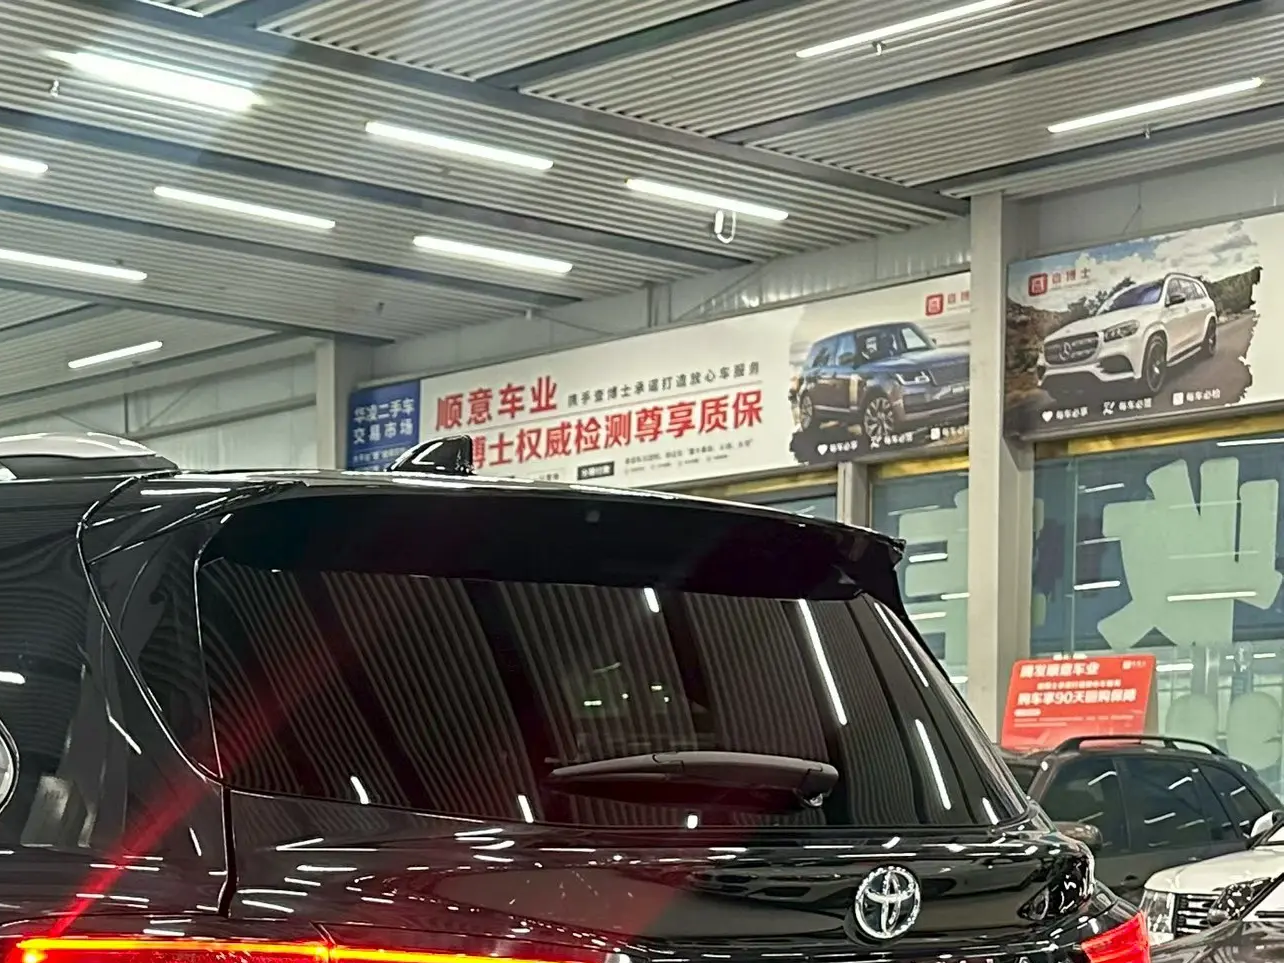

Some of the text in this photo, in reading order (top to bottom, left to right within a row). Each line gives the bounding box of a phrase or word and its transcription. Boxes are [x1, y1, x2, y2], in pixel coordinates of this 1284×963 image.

[567, 361, 760, 407] 携手查博士承诺打造放心车服务
[353, 397, 415, 424] 华凌二手车
[434, 375, 558, 431] 顺意车业
[353, 418, 414, 445] 交易市场
